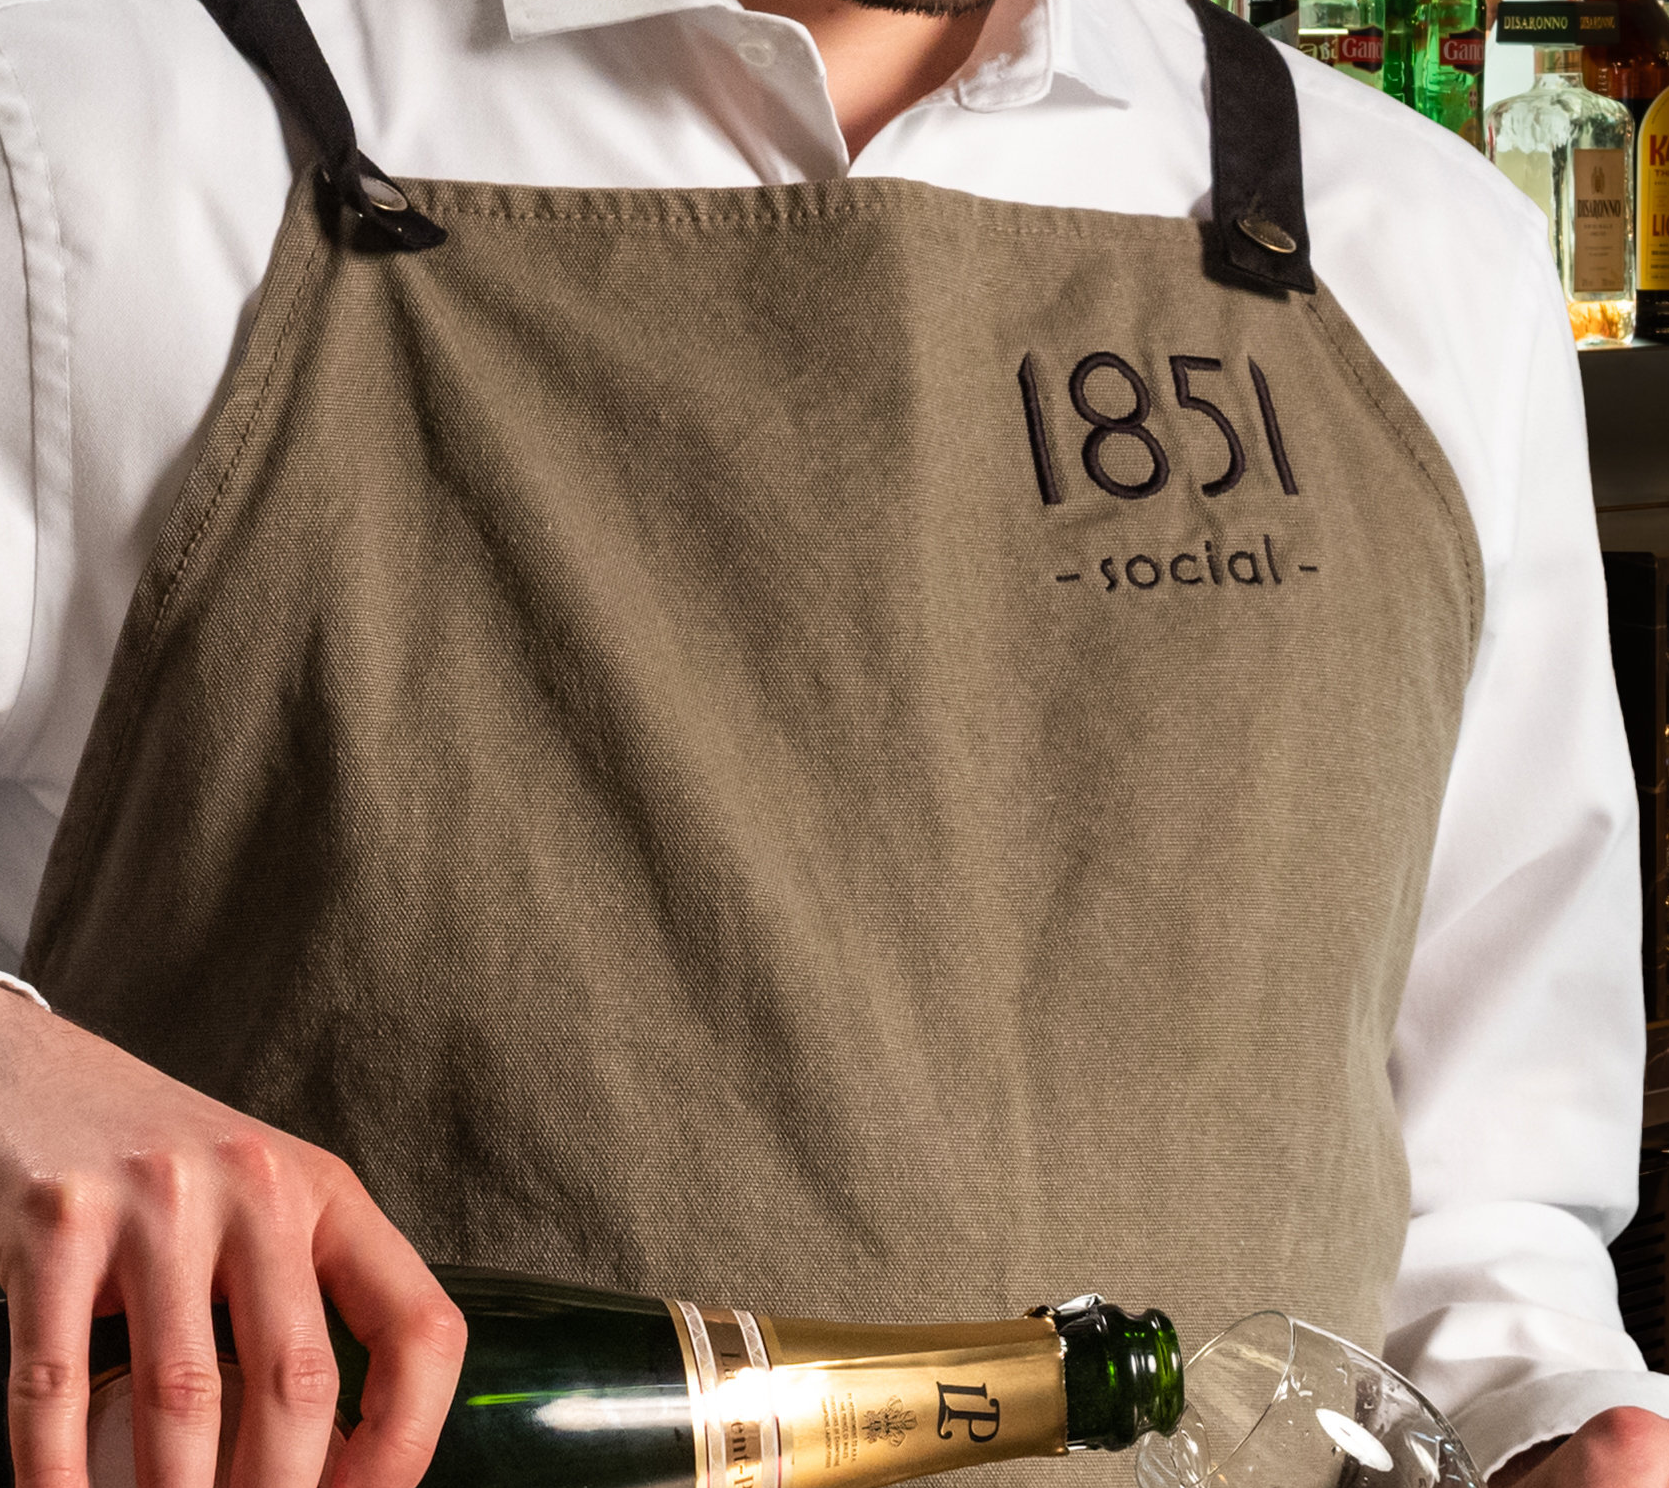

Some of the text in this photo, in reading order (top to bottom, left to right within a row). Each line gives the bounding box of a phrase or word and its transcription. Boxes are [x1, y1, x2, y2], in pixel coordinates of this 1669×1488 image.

[1503, 15, 1569, 31] DISARONNO
[1577, 199, 1622, 220] DISARONNO
[1017, 350, 1300, 506] 1851
